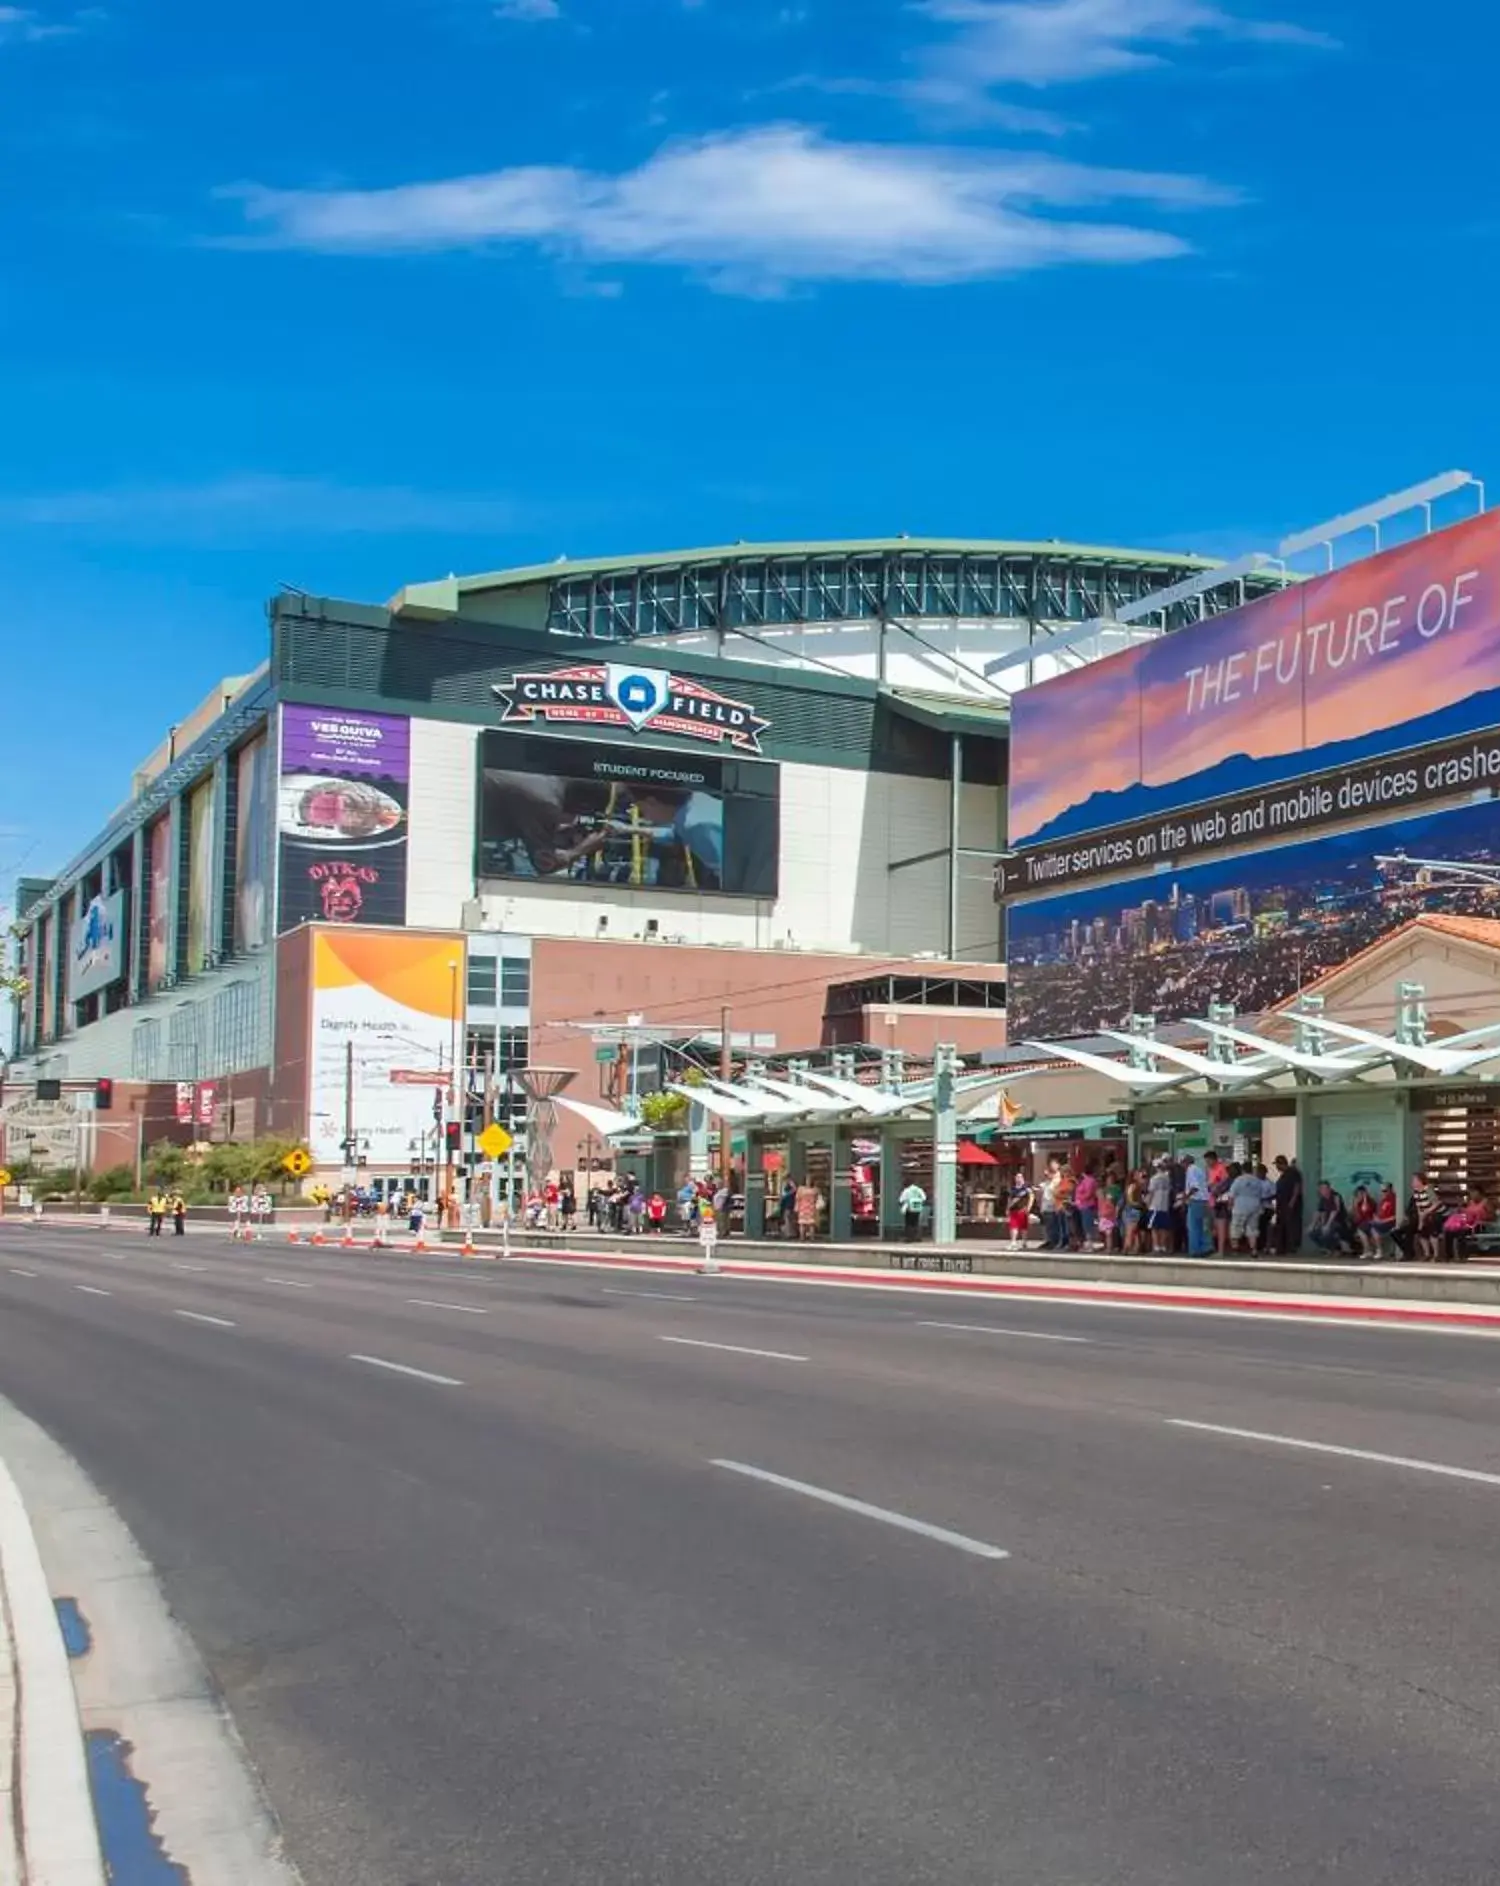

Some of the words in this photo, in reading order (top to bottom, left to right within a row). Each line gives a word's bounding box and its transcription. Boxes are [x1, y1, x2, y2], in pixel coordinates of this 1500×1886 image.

[1184, 651, 1248, 715] THE
[1253, 595, 1406, 693] FUTURE
[1416, 571, 1479, 638] OF
[523, 683, 602, 701] CHASE
[673, 697, 746, 725] FIELD
[1025, 856, 1070, 882] Twitter
[1072, 840, 1133, 872] services
[1137, 835, 1157, 856] on
[1160, 823, 1187, 851] the
[1191, 811, 1227, 845] web
[1231, 800, 1265, 836] and
[1269, 786, 1333, 826] mobile
[1338, 769, 1419, 810] devices
